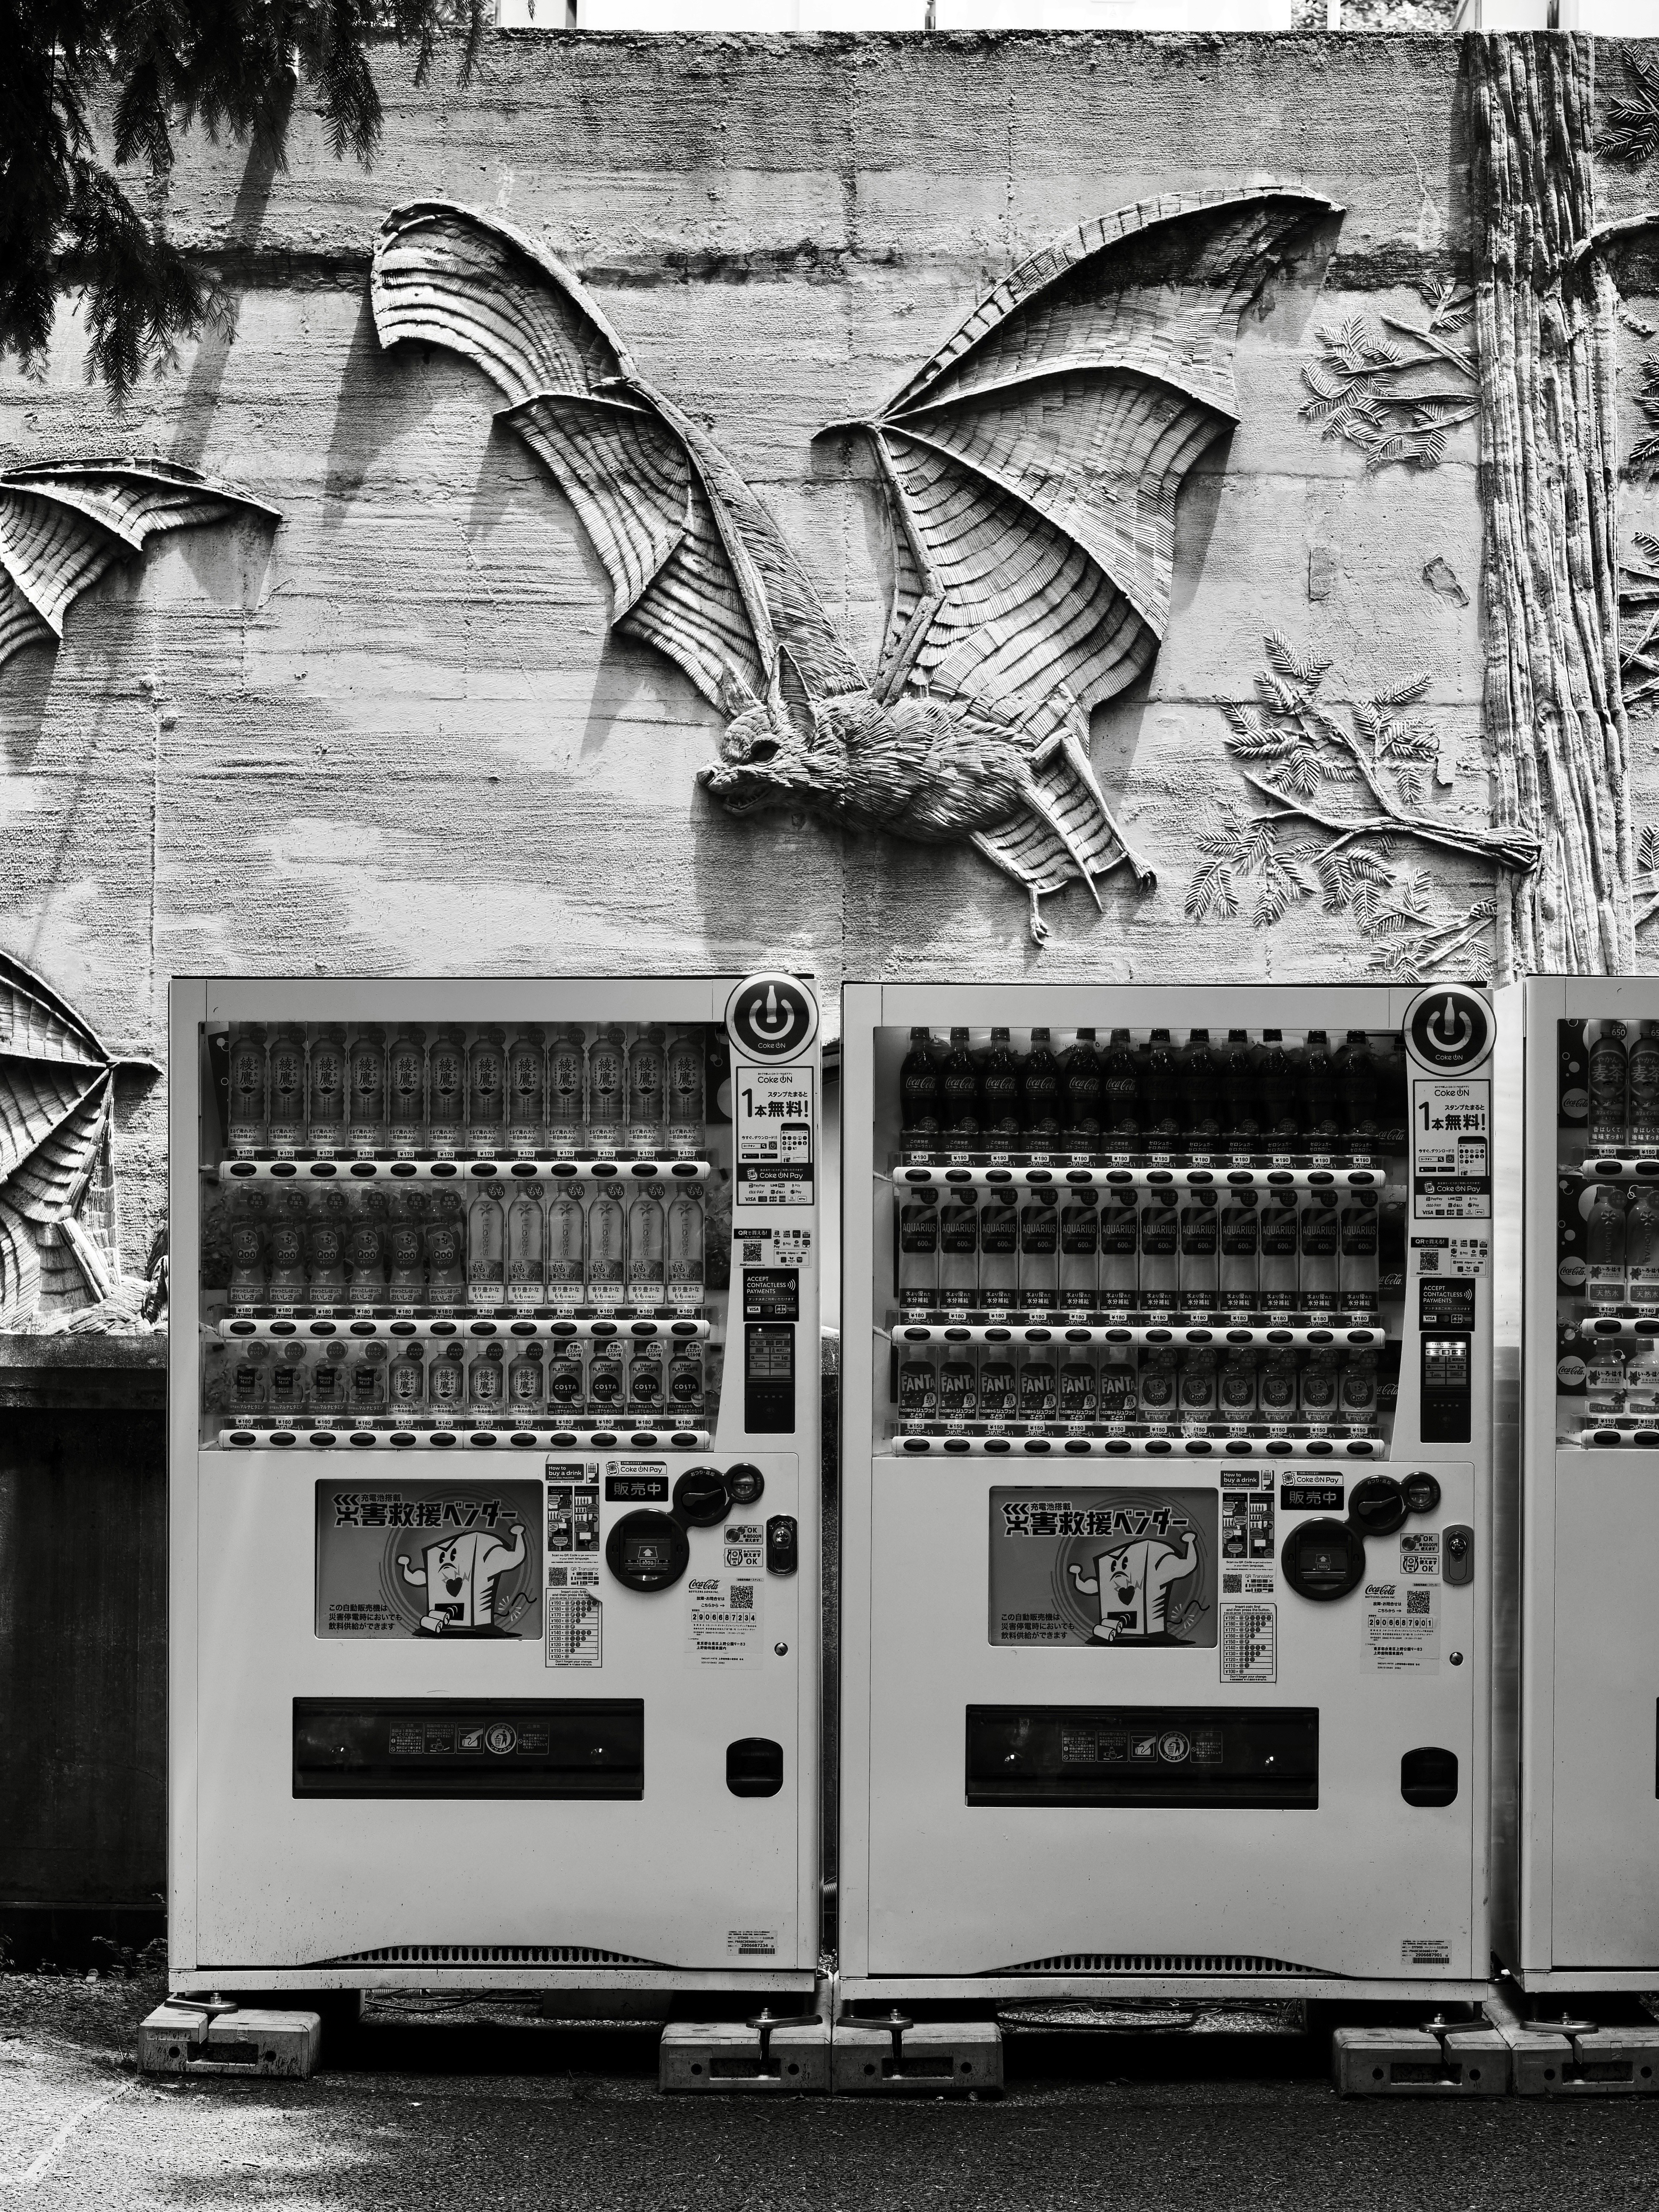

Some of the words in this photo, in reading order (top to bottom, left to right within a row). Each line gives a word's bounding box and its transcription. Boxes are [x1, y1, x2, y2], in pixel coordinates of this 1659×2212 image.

[1591, 1066, 1624, 1082] 麦茶
[1457, 1088, 1469, 1097] ON
[488, 1187, 504, 1196] もも
[902, 1223, 936, 1234] AQUARIUS
[1596, 1289, 1619, 1297] 天然水
[614, 1481, 662, 1496] 販売中
[361, 1494, 402, 1502] 充電池搭載
[1289, 1490, 1337, 1505] 販売中
[333, 1494, 517, 1528] 災害救援ベンダー
[1030, 1502, 1071, 1511] 充電池搭載
[1002, 1503, 1189, 1536] 災害救援ベンダー
[689, 1579, 720, 1590] Coca-Cola
[1365, 1584, 1397, 1595] Coca-Cola
[490, 1744, 512, 1752] リサイクル
